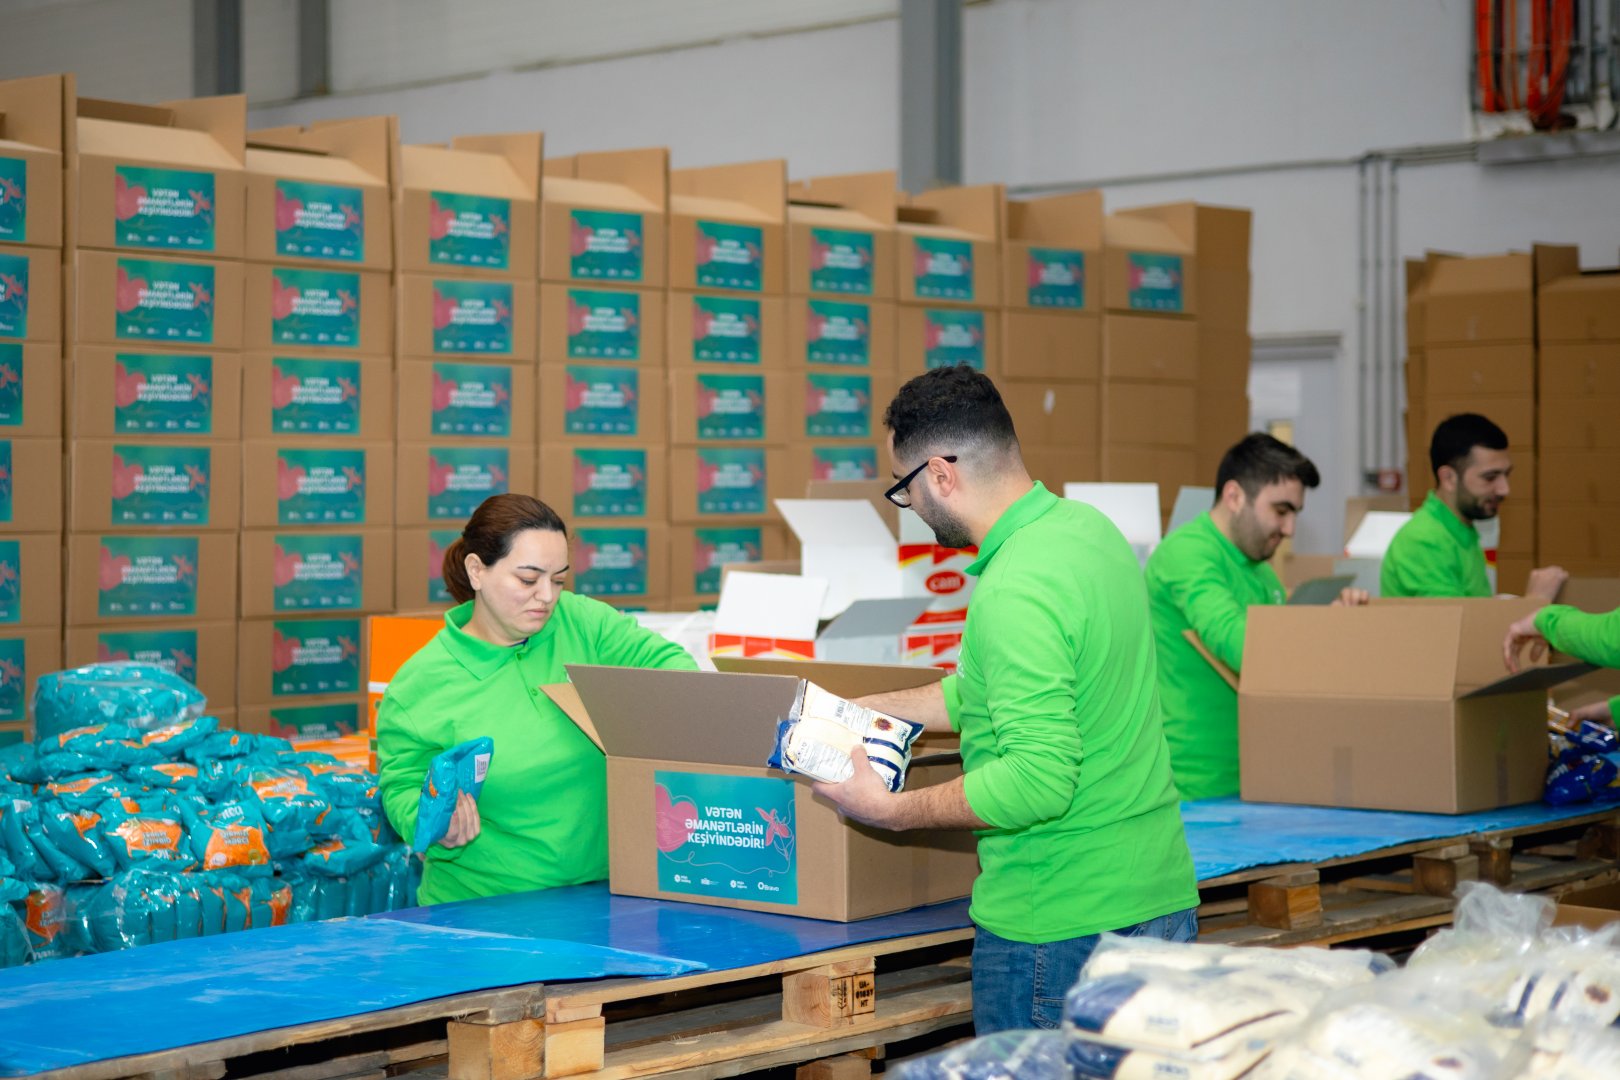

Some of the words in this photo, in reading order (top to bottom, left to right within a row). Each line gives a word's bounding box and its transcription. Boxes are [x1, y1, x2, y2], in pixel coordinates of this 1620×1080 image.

[705, 806, 742, 819] VƏTƏN
[685, 818, 764, 835] ƏMANƏTLƏRİN
[687, 831, 765, 849] KEŞİYİNDƏDİR!
